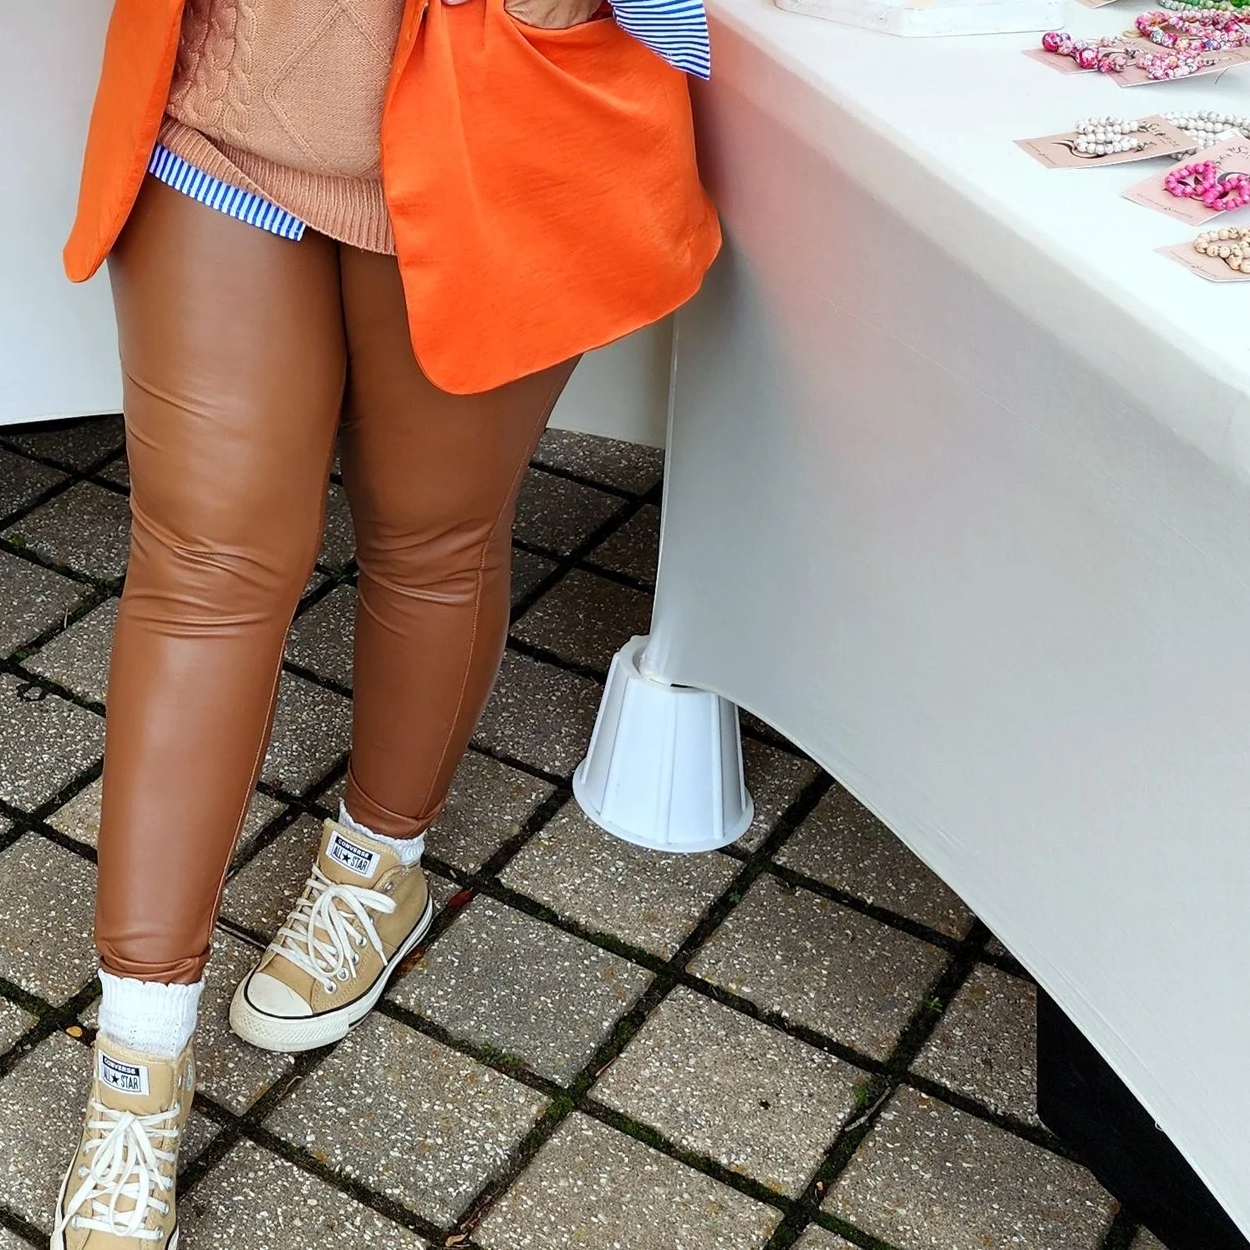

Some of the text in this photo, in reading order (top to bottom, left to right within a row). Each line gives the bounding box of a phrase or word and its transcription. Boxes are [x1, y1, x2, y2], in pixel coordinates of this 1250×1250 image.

[337, 838, 371, 859] CONVERSE
[350, 855, 369, 872] STAR
[120, 1074, 140, 1090] STAR
